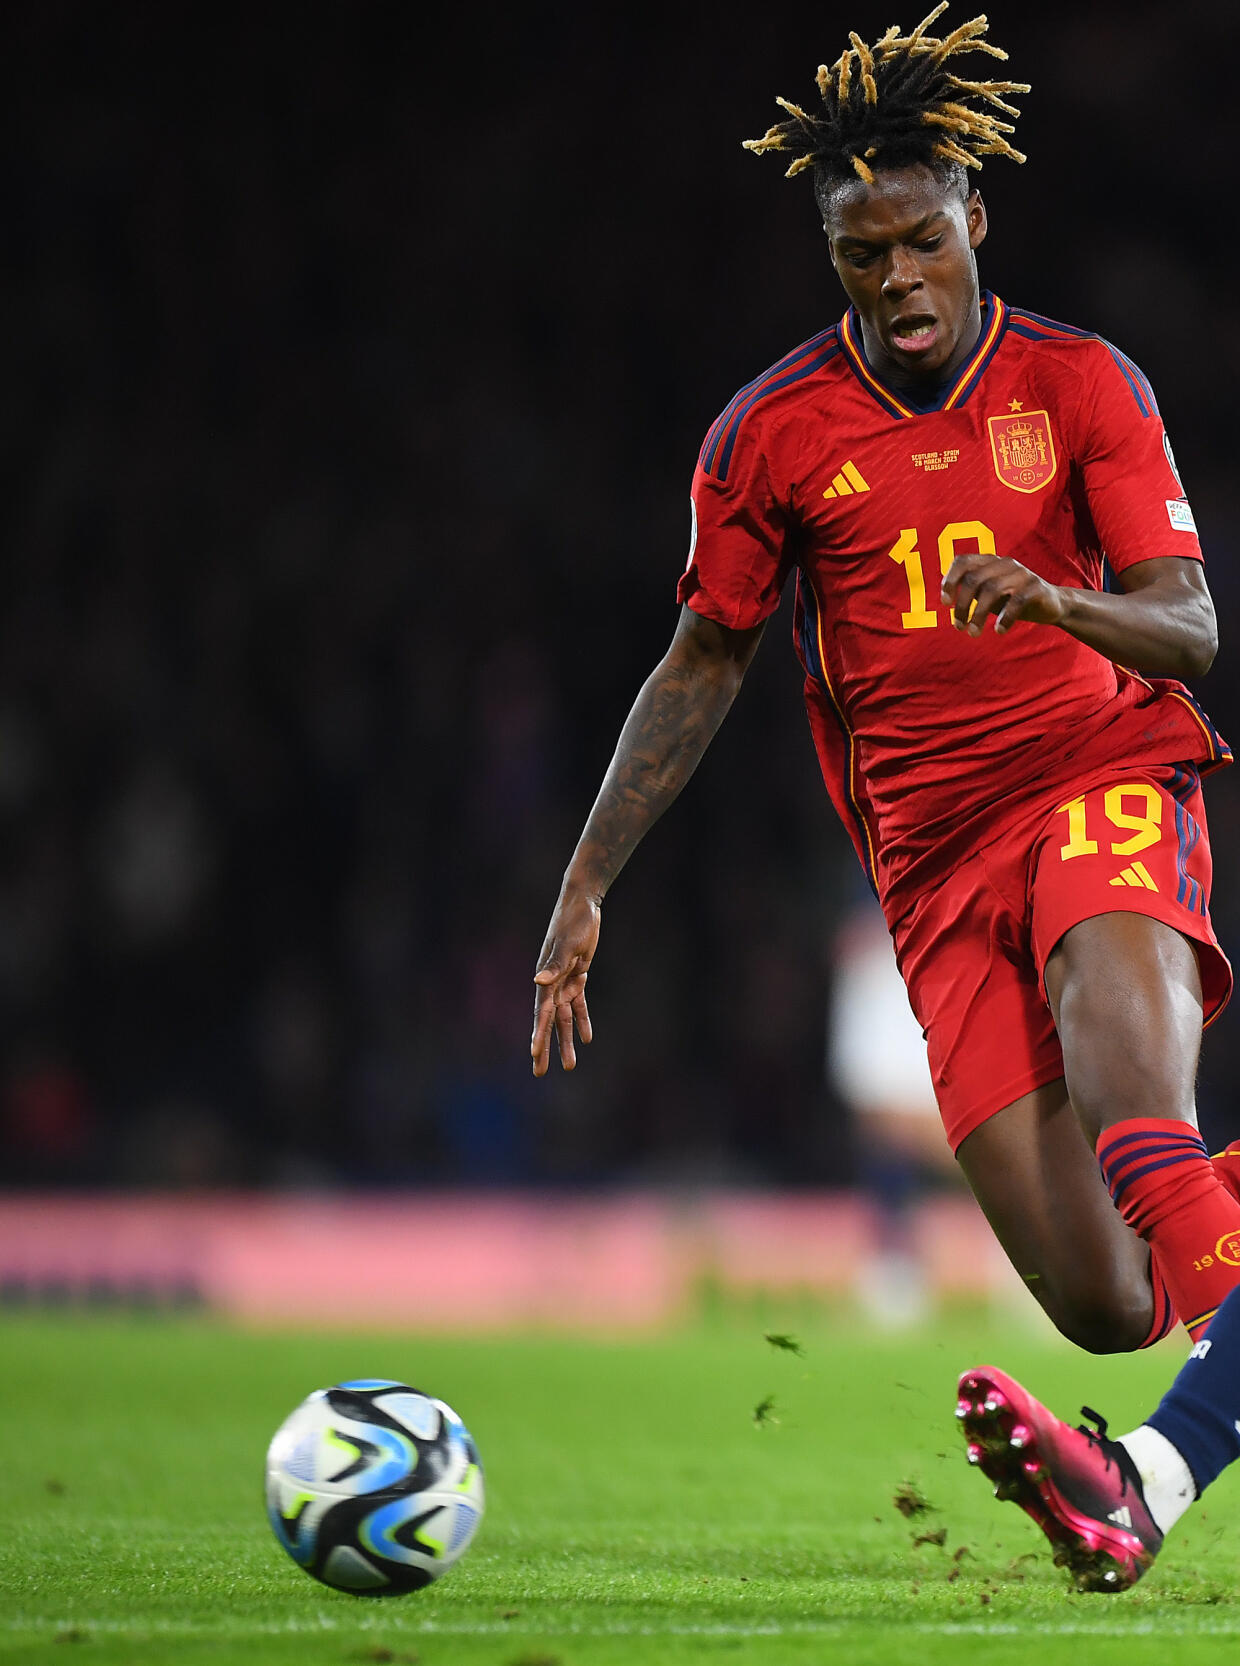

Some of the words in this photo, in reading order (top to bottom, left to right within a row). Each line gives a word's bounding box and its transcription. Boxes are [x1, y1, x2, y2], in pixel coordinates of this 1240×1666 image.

[911, 452, 938, 461] SCOTLAND
[943, 449, 960, 457] SPAIN
[924, 457, 942, 465] MARCH
[943, 455, 958, 463] 2023
[924, 463, 949, 471] GLASGOW
[1055, 783, 1163, 862] 19
[1193, 1254, 1214, 1271] 19
